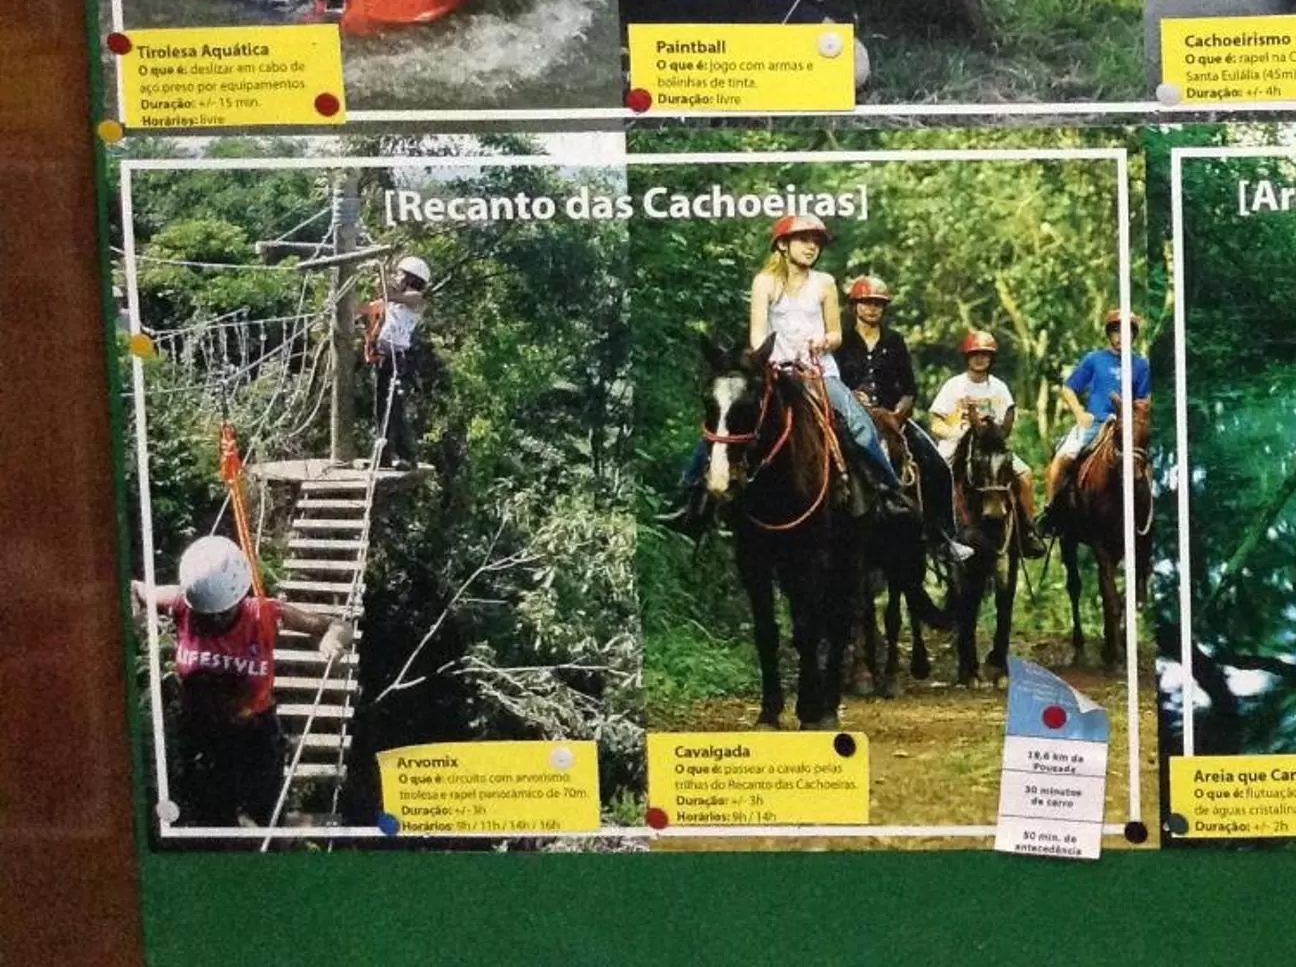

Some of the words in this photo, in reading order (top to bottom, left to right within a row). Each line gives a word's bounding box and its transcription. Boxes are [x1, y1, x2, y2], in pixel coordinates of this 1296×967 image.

[657, 40, 726, 54] Paintball
[1185, 32, 1291, 48] Cachoeirismo
[137, 44, 196, 58] Tirolesa
[202, 43, 269, 60] Aquática
[657, 60, 666, 71] O
[670, 60, 693, 72] que
[709, 59, 736, 73] jogo
[740, 59, 764, 71] com
[768, 60, 802, 71] armas
[807, 60, 813, 71] e
[1185, 54, 1195, 65] O
[1198, 54, 1221, 67] que
[1239, 52, 1269, 66] rapel
[1271, 52, 1286, 62] na
[139, 65, 148, 75] O
[151, 66, 173, 78] que
[190, 61, 233, 74] deslizar
[237, 63, 255, 73] em
[259, 60, 286, 73] cabo
[291, 59, 304, 71] de
[1187, 70, 1218, 82] Santa
[1222, 68, 1259, 81] Eulália
[1263, 68, 1296, 81] (45m)
[198, 81, 217, 93] por
[221, 79, 305, 92] equipamentos
[657, 77, 707, 88] bolinhas
[710, 76, 724, 88] de
[658, 94, 714, 106] Duração:
[717, 94, 741, 104] livre
[1187, 87, 1243, 100] Duração:
[141, 98, 194, 111] Duração:
[220, 97, 232, 108] 15
[384, 187, 555, 226] [Recanto
[566, 187, 632, 219] das
[643, 184, 868, 220] Cachoeiras]
[675, 745, 750, 760] Cavalgada
[397, 755, 459, 768] Arvomix
[675, 764, 684, 774] O
[687, 764, 709, 776] que
[1194, 769, 1234, 782] Areia
[1238, 772, 1267, 785] que
[399, 774, 408, 784] O
[410, 774, 432, 786] que
[711, 779, 725, 791] do
[728, 780, 773, 791] Recanto
[776, 779, 794, 790] das
[546, 787, 560, 798] de
[1194, 788, 1203, 799] O
[1206, 789, 1230, 801] que
[677, 795, 728, 808] Duração:
[402, 805, 451, 817] Duração:
[1194, 804, 1209, 816] de
[1213, 804, 1246, 819] águas
[1195, 821, 1250, 833] Duração:
